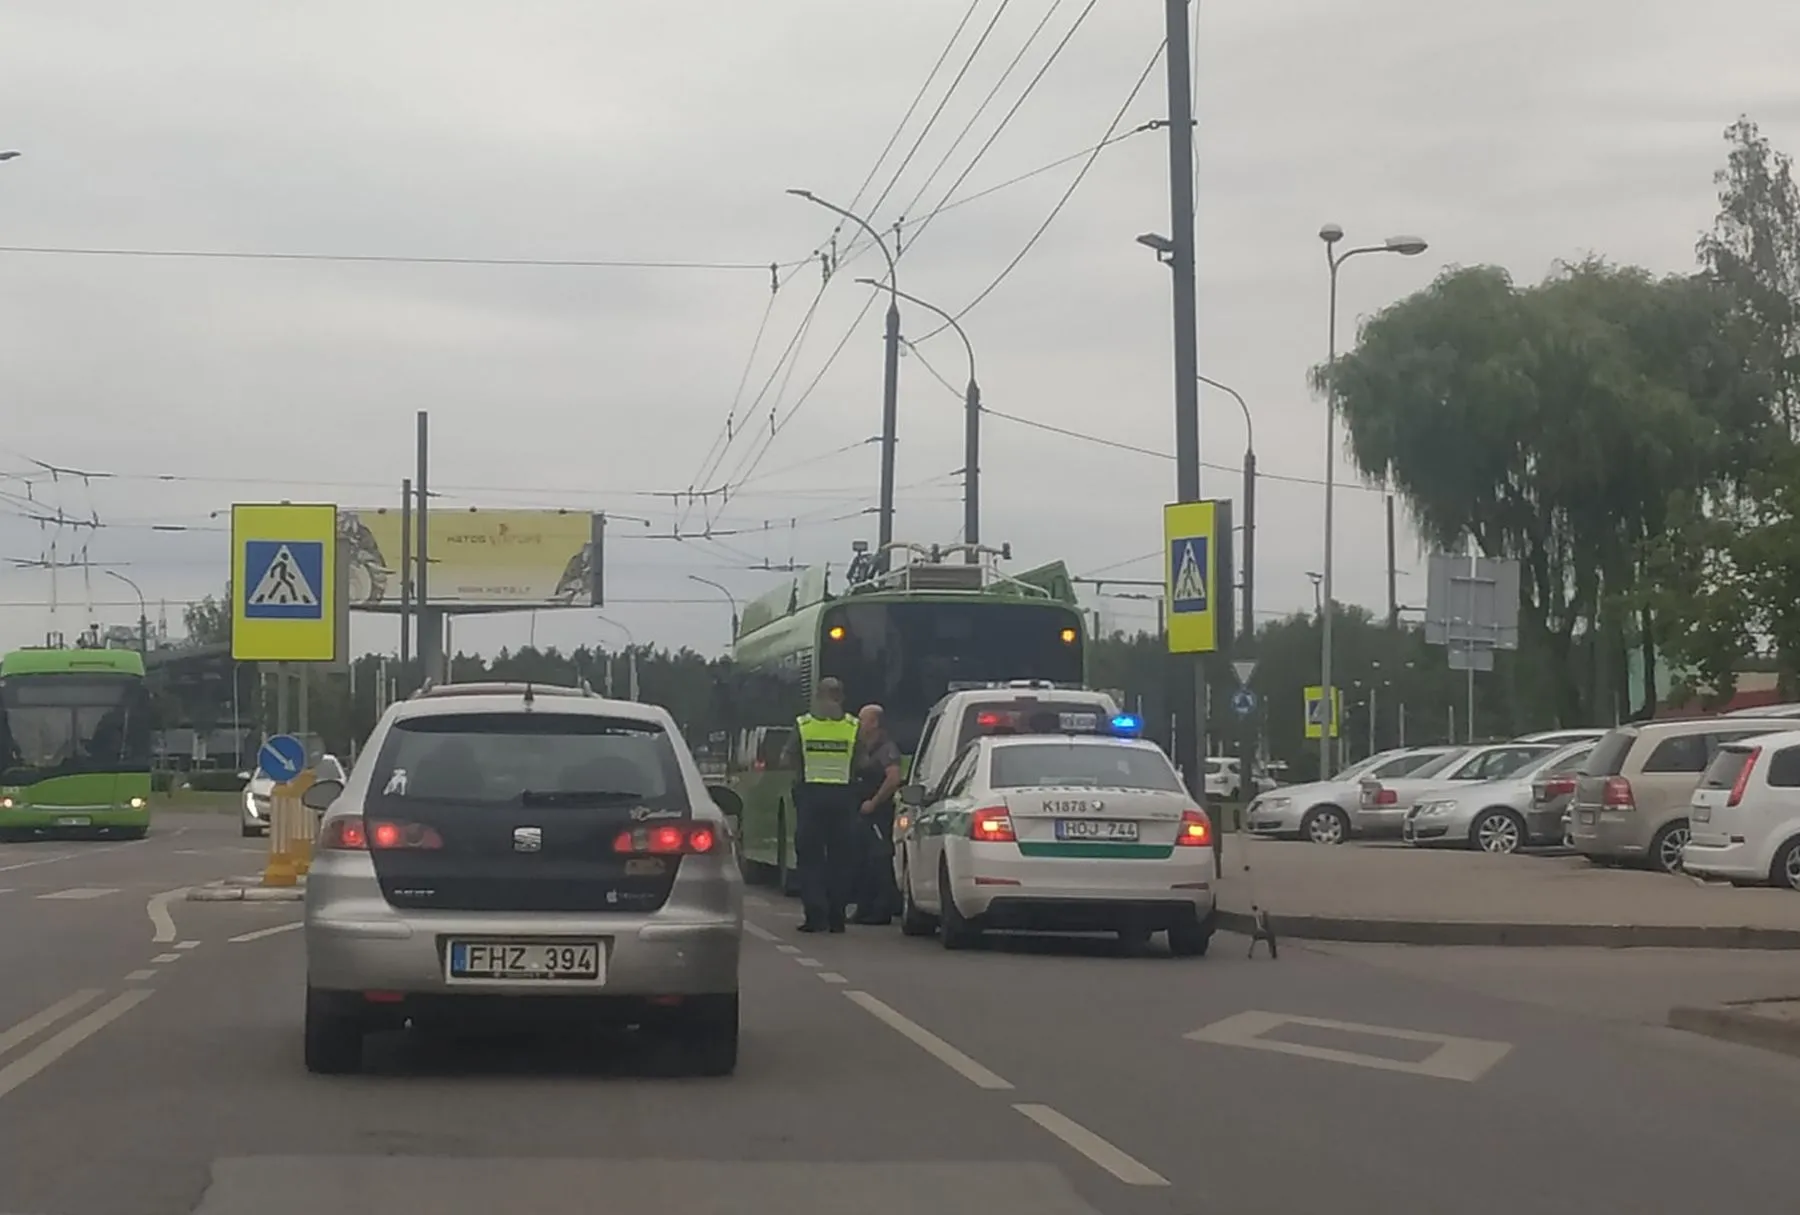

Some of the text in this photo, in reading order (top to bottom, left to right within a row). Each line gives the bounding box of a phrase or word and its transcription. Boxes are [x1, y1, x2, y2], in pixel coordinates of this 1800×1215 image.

[1042, 800, 1087, 813] K1878
[1107, 823, 1136, 837] 744
[469, 946, 592, 971] FHZ 394
